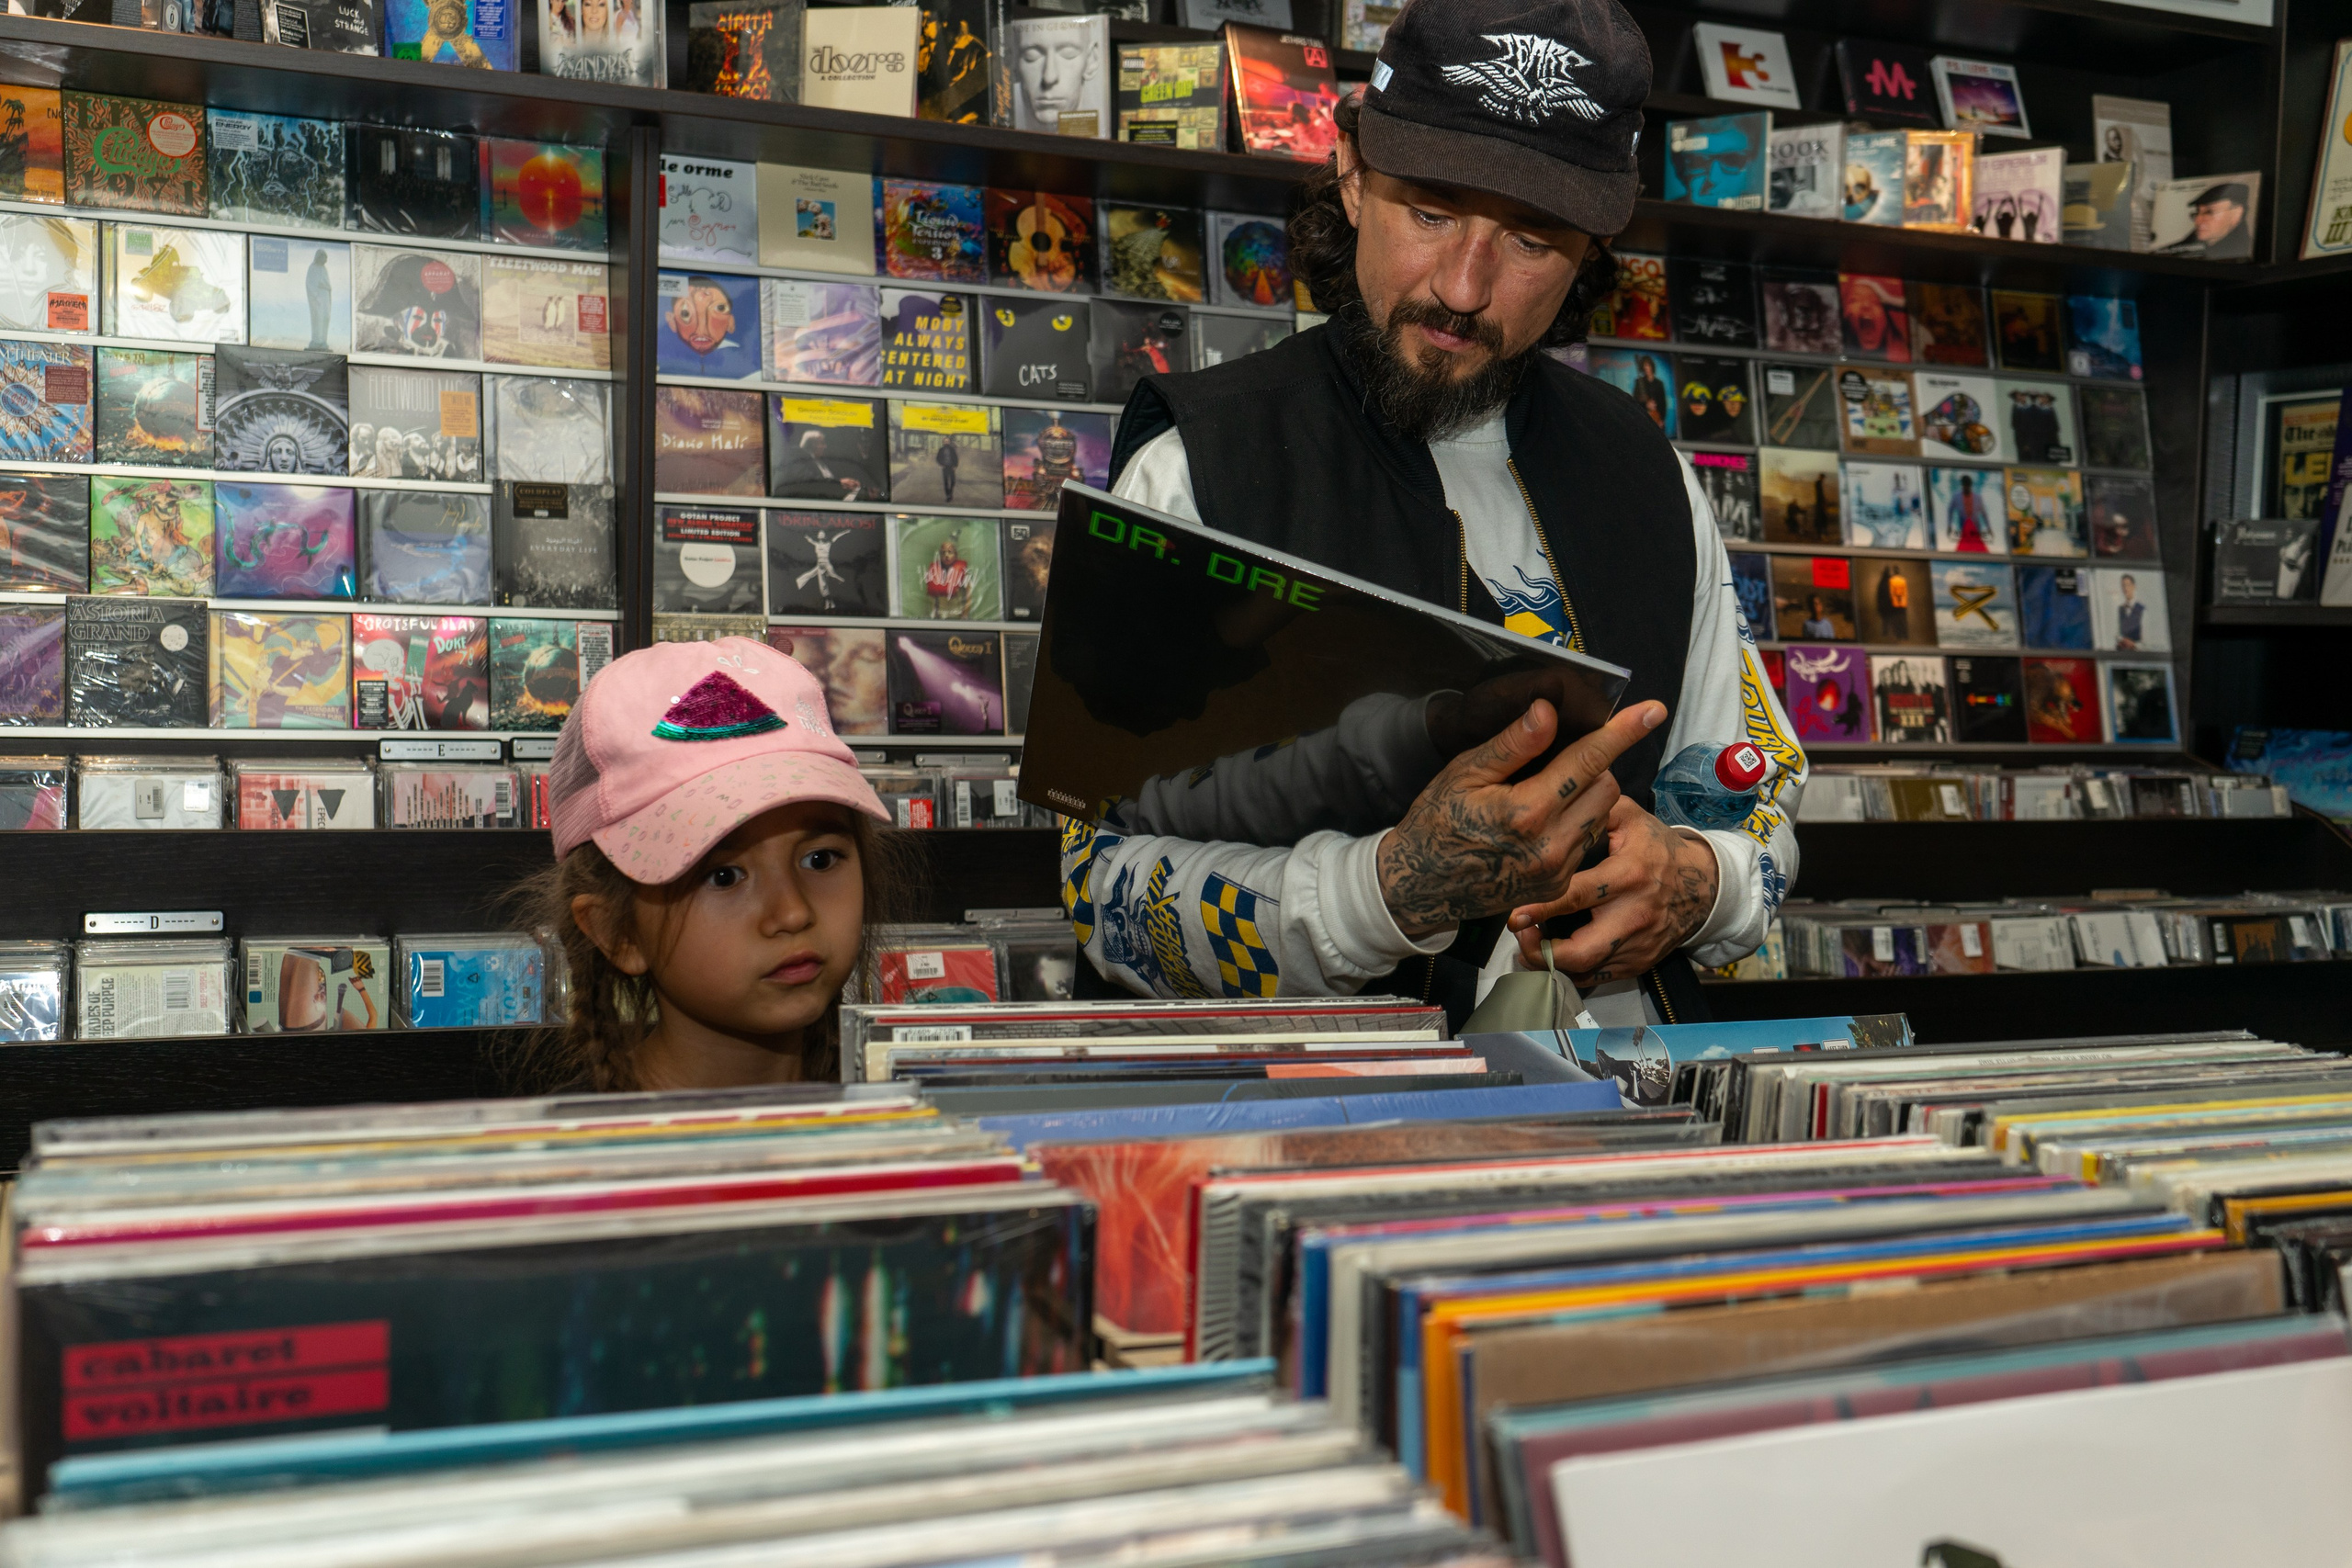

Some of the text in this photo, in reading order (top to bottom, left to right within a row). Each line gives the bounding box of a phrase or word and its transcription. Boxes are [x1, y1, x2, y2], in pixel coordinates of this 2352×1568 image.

[338, 6, 359, 19] LUCK
[717, 11, 773, 31] CIRITH
[810, 46, 905, 73] doors
[216, 121, 252, 130] ENERGY
[94, 127, 181, 176] Chicago
[683, 163, 733, 178] orme
[490, 258, 602, 276] FLEETWOOD MAC
[915, 315, 965, 333] MOBY
[894, 332, 966, 351] ALWAYS
[884, 369, 967, 389] AT NIGHT
[1019, 364, 1057, 387] CATS
[369, 374, 435, 412] FLEETWOOD
[680, 513, 741, 523] GOTAN PROJECT
[711, 529, 741, 537] EDITION
[1089, 511, 1326, 612] DR. DRE
[70, 605, 166, 624] ASTORIA
[70, 625, 151, 642] GRAND
[433, 636, 467, 654] DUKE
[437, 743, 446, 757] E
[1047, 790, 1087, 809] ADVISORY
[150, 915, 159, 930] D
[88, 991, 100, 1004] OF
[102, 977, 115, 1018] PURPLE
[81, 1335, 295, 1378] cabaret
[83, 1383, 313, 1427] voltaire
